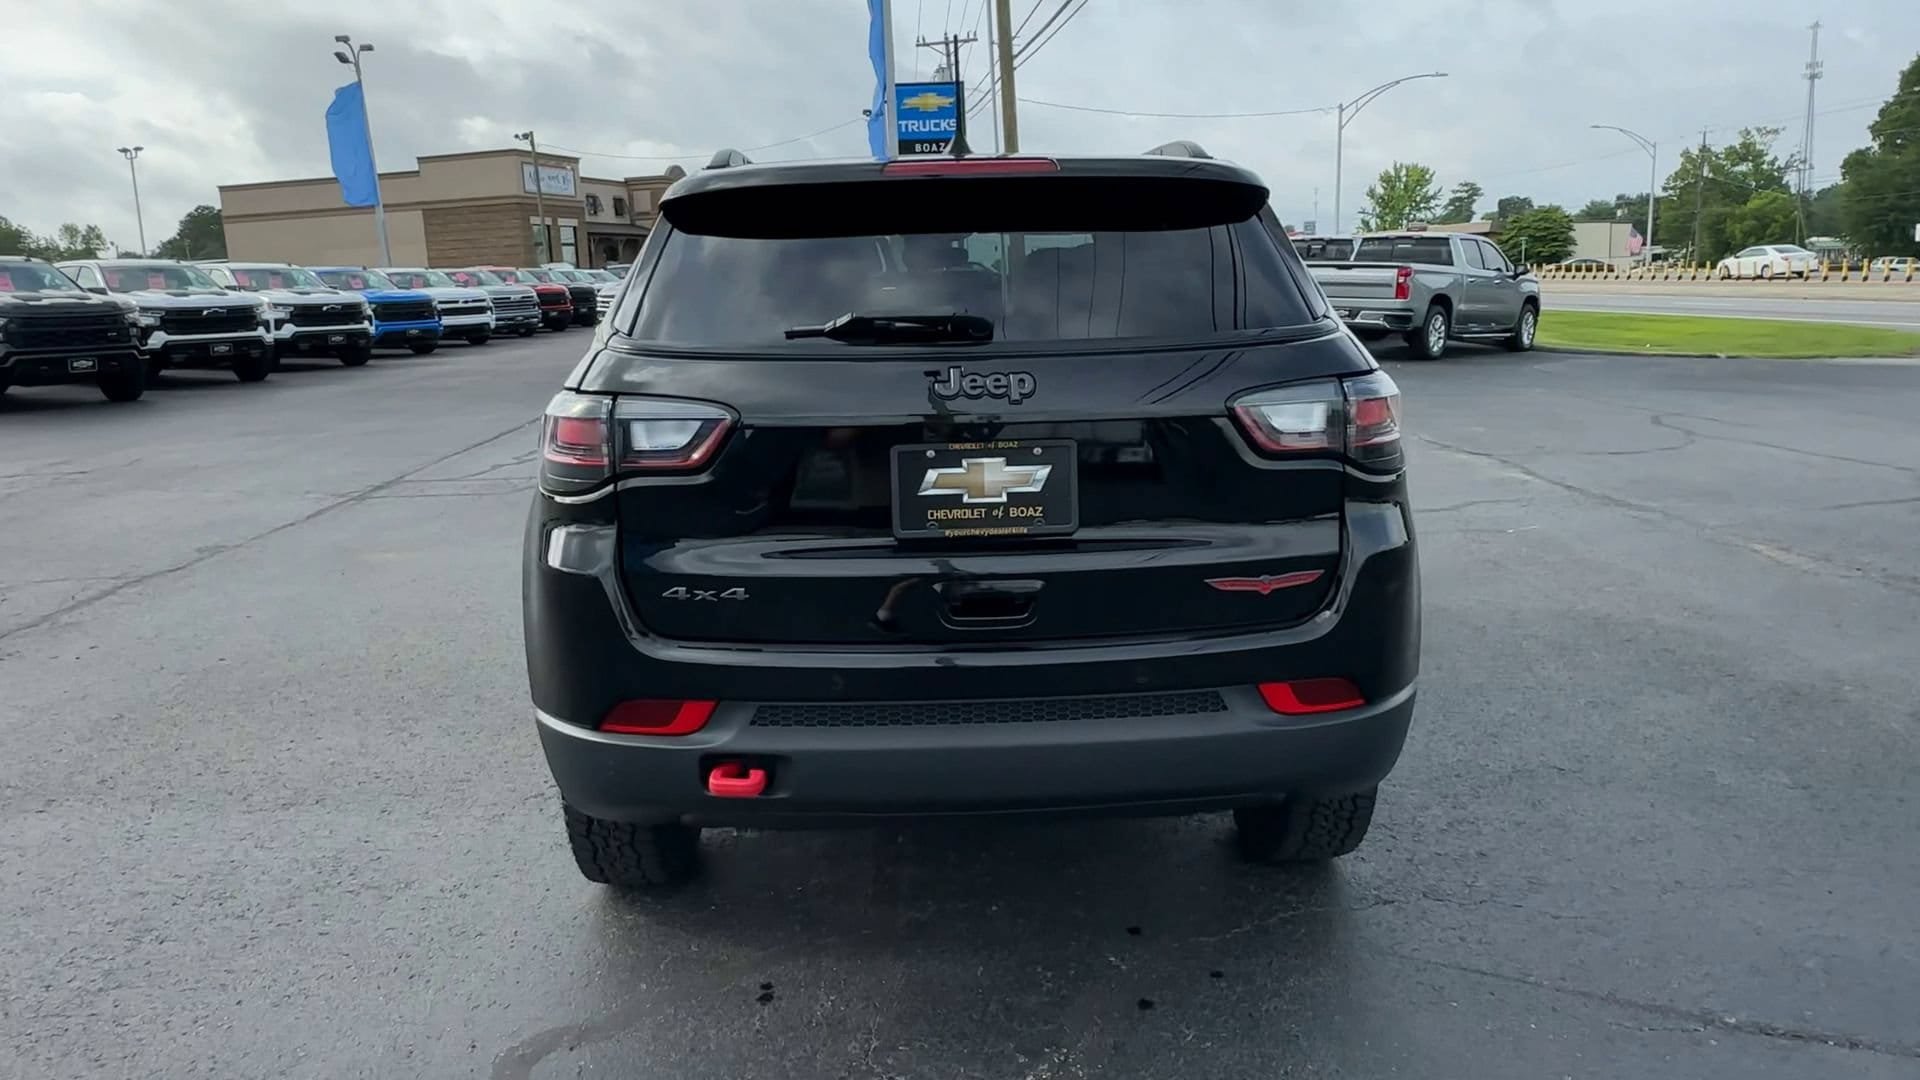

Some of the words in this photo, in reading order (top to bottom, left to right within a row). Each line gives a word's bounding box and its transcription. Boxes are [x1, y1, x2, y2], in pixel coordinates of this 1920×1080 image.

[898, 119, 957, 132] TRUCKS
[914, 142, 946, 153] BOAZ
[933, 366, 1037, 405] Jeep
[998, 440, 1019, 449] BOAZ
[927, 508, 986, 519] CHEVROLET
[992, 506, 1004, 519] of
[1009, 506, 1044, 518] BOAZ
